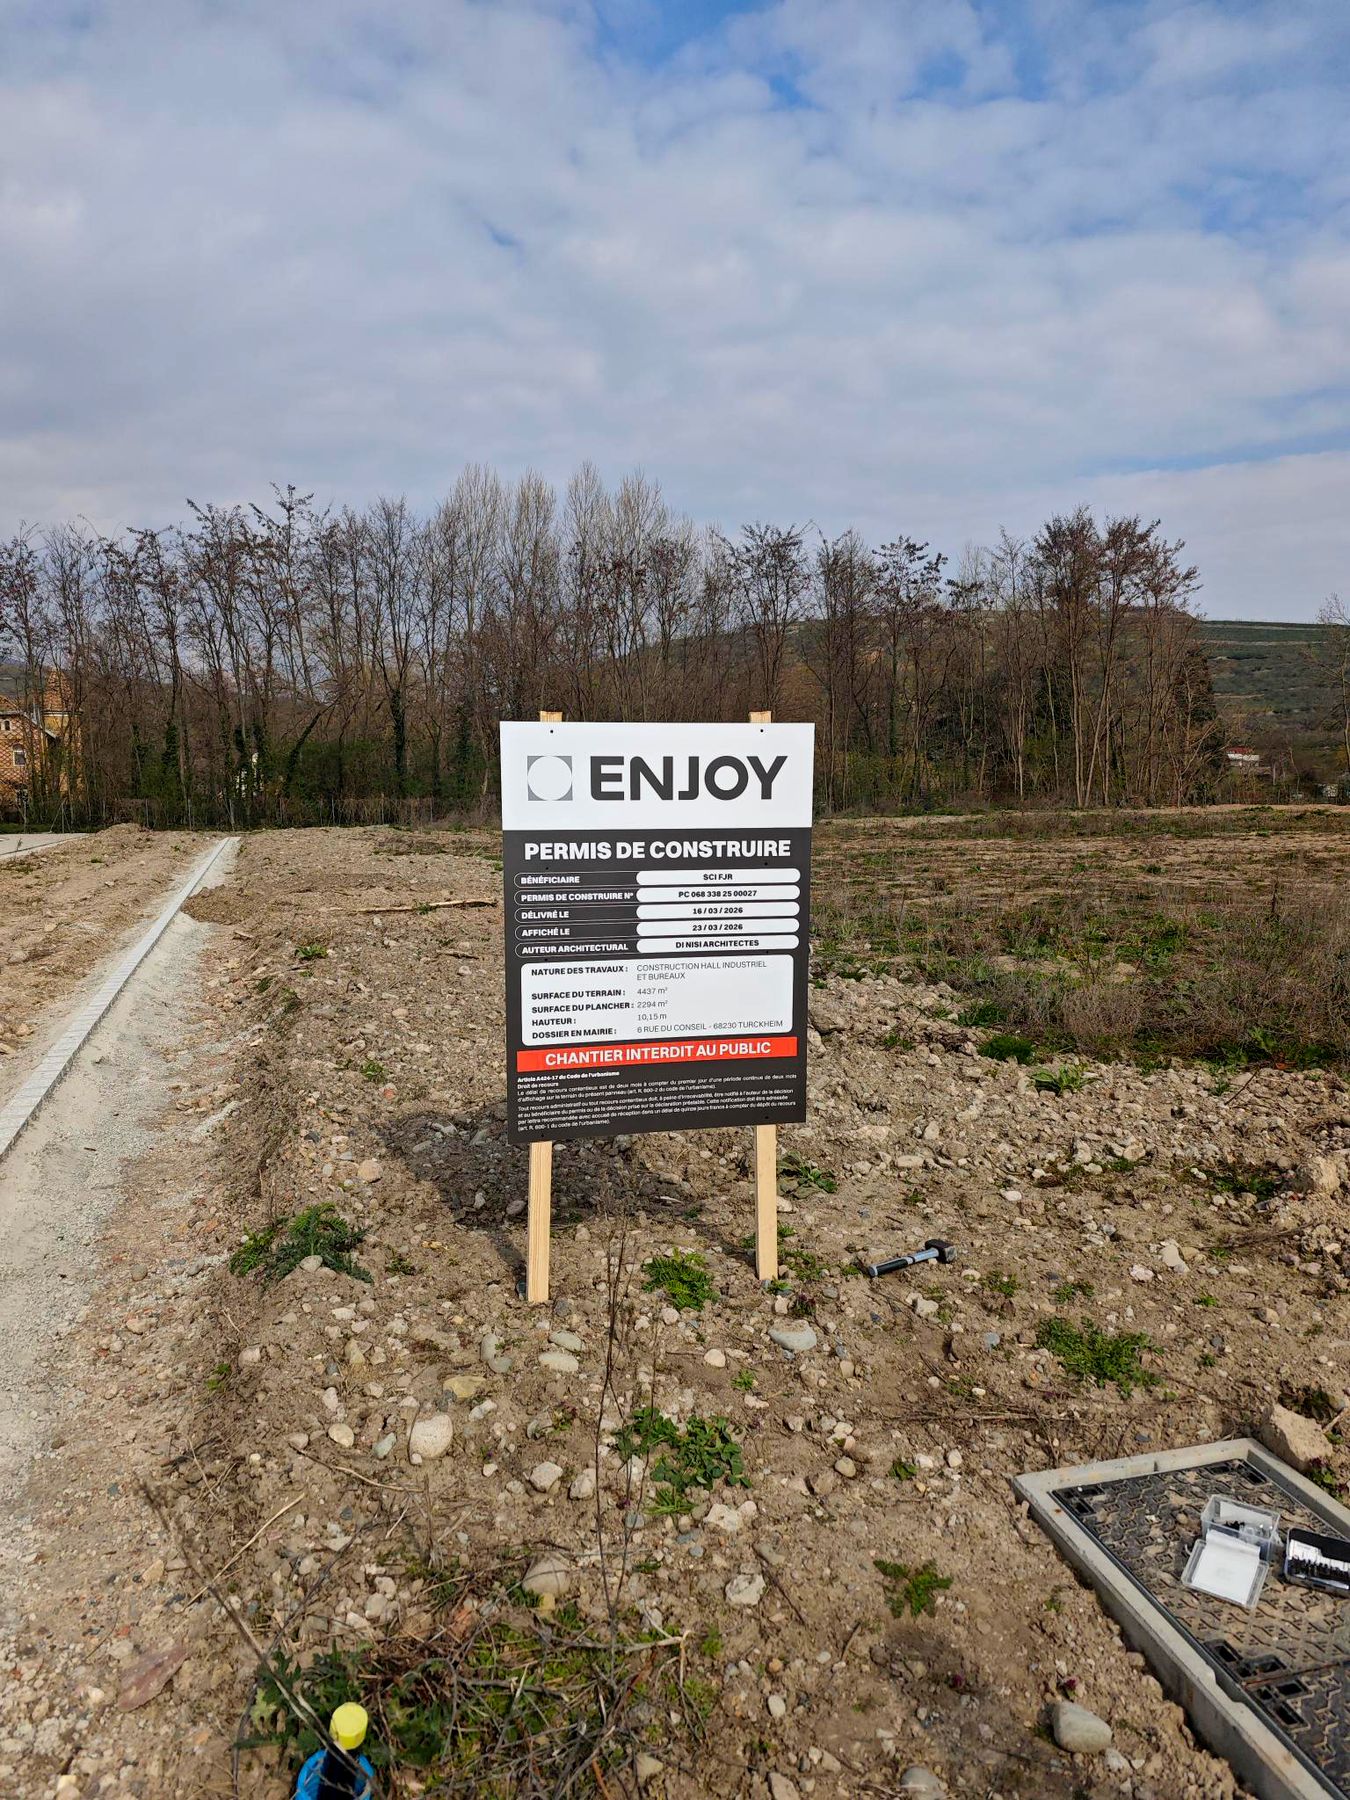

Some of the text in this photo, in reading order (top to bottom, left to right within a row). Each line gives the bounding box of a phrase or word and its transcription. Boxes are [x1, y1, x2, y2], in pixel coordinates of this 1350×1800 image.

[590, 755, 788, 801] ENJOY
[524, 839, 791, 860] PERMIS DE CONSTRUIRE
[521, 876, 580, 884] BÉNÉFICIAIRE
[718, 873, 733, 881] FJR
[521, 894, 554, 902] PERMIS
[555, 893, 567, 901] DE
[568, 892, 623, 901] CONSTRUIRE
[521, 910, 558, 919] DÉLIVRÉ
[521, 927, 559, 937] AFFICHÉ
[522, 943, 629, 954] AUTEUR ARCHITECTURAL
[703, 939, 760, 948] ARCHITECTES
[531, 968, 565, 976] NATURE
[567, 967, 584, 975] DES
[585, 965, 624, 974] TRAVAUX
[636, 961, 767, 972] CONSTRUCTION HALL INDUSTRIEL
[637, 972, 686, 981] ET BUREAUX
[532, 992, 570, 1000] SURFACE
[585, 989, 621, 998] TERRAIN
[657, 987, 668, 995] m²
[532, 1005, 570, 1014] SURFACE
[572, 1004, 585, 1012] DU
[585, 1002, 630, 1011] PLANCHER
[637, 1000, 668, 1009] 2294 m²
[532, 1018, 572, 1026] HAUTEUR
[637, 1014, 659, 1022] 10,15
[637, 1026, 642, 1034] 6
[643, 1025, 659, 1033] RUE
[674, 1023, 707, 1032] CONSEIL
[713, 1022, 737, 1030] 68230
[738, 1020, 783, 1029] TURCKHEIM
[532, 1030, 569, 1039] DOSSIER
[583, 1028, 613, 1036] MAIRIE
[545, 1041, 771, 1066] CHANTIER INTERDIT AU PUBLIC
